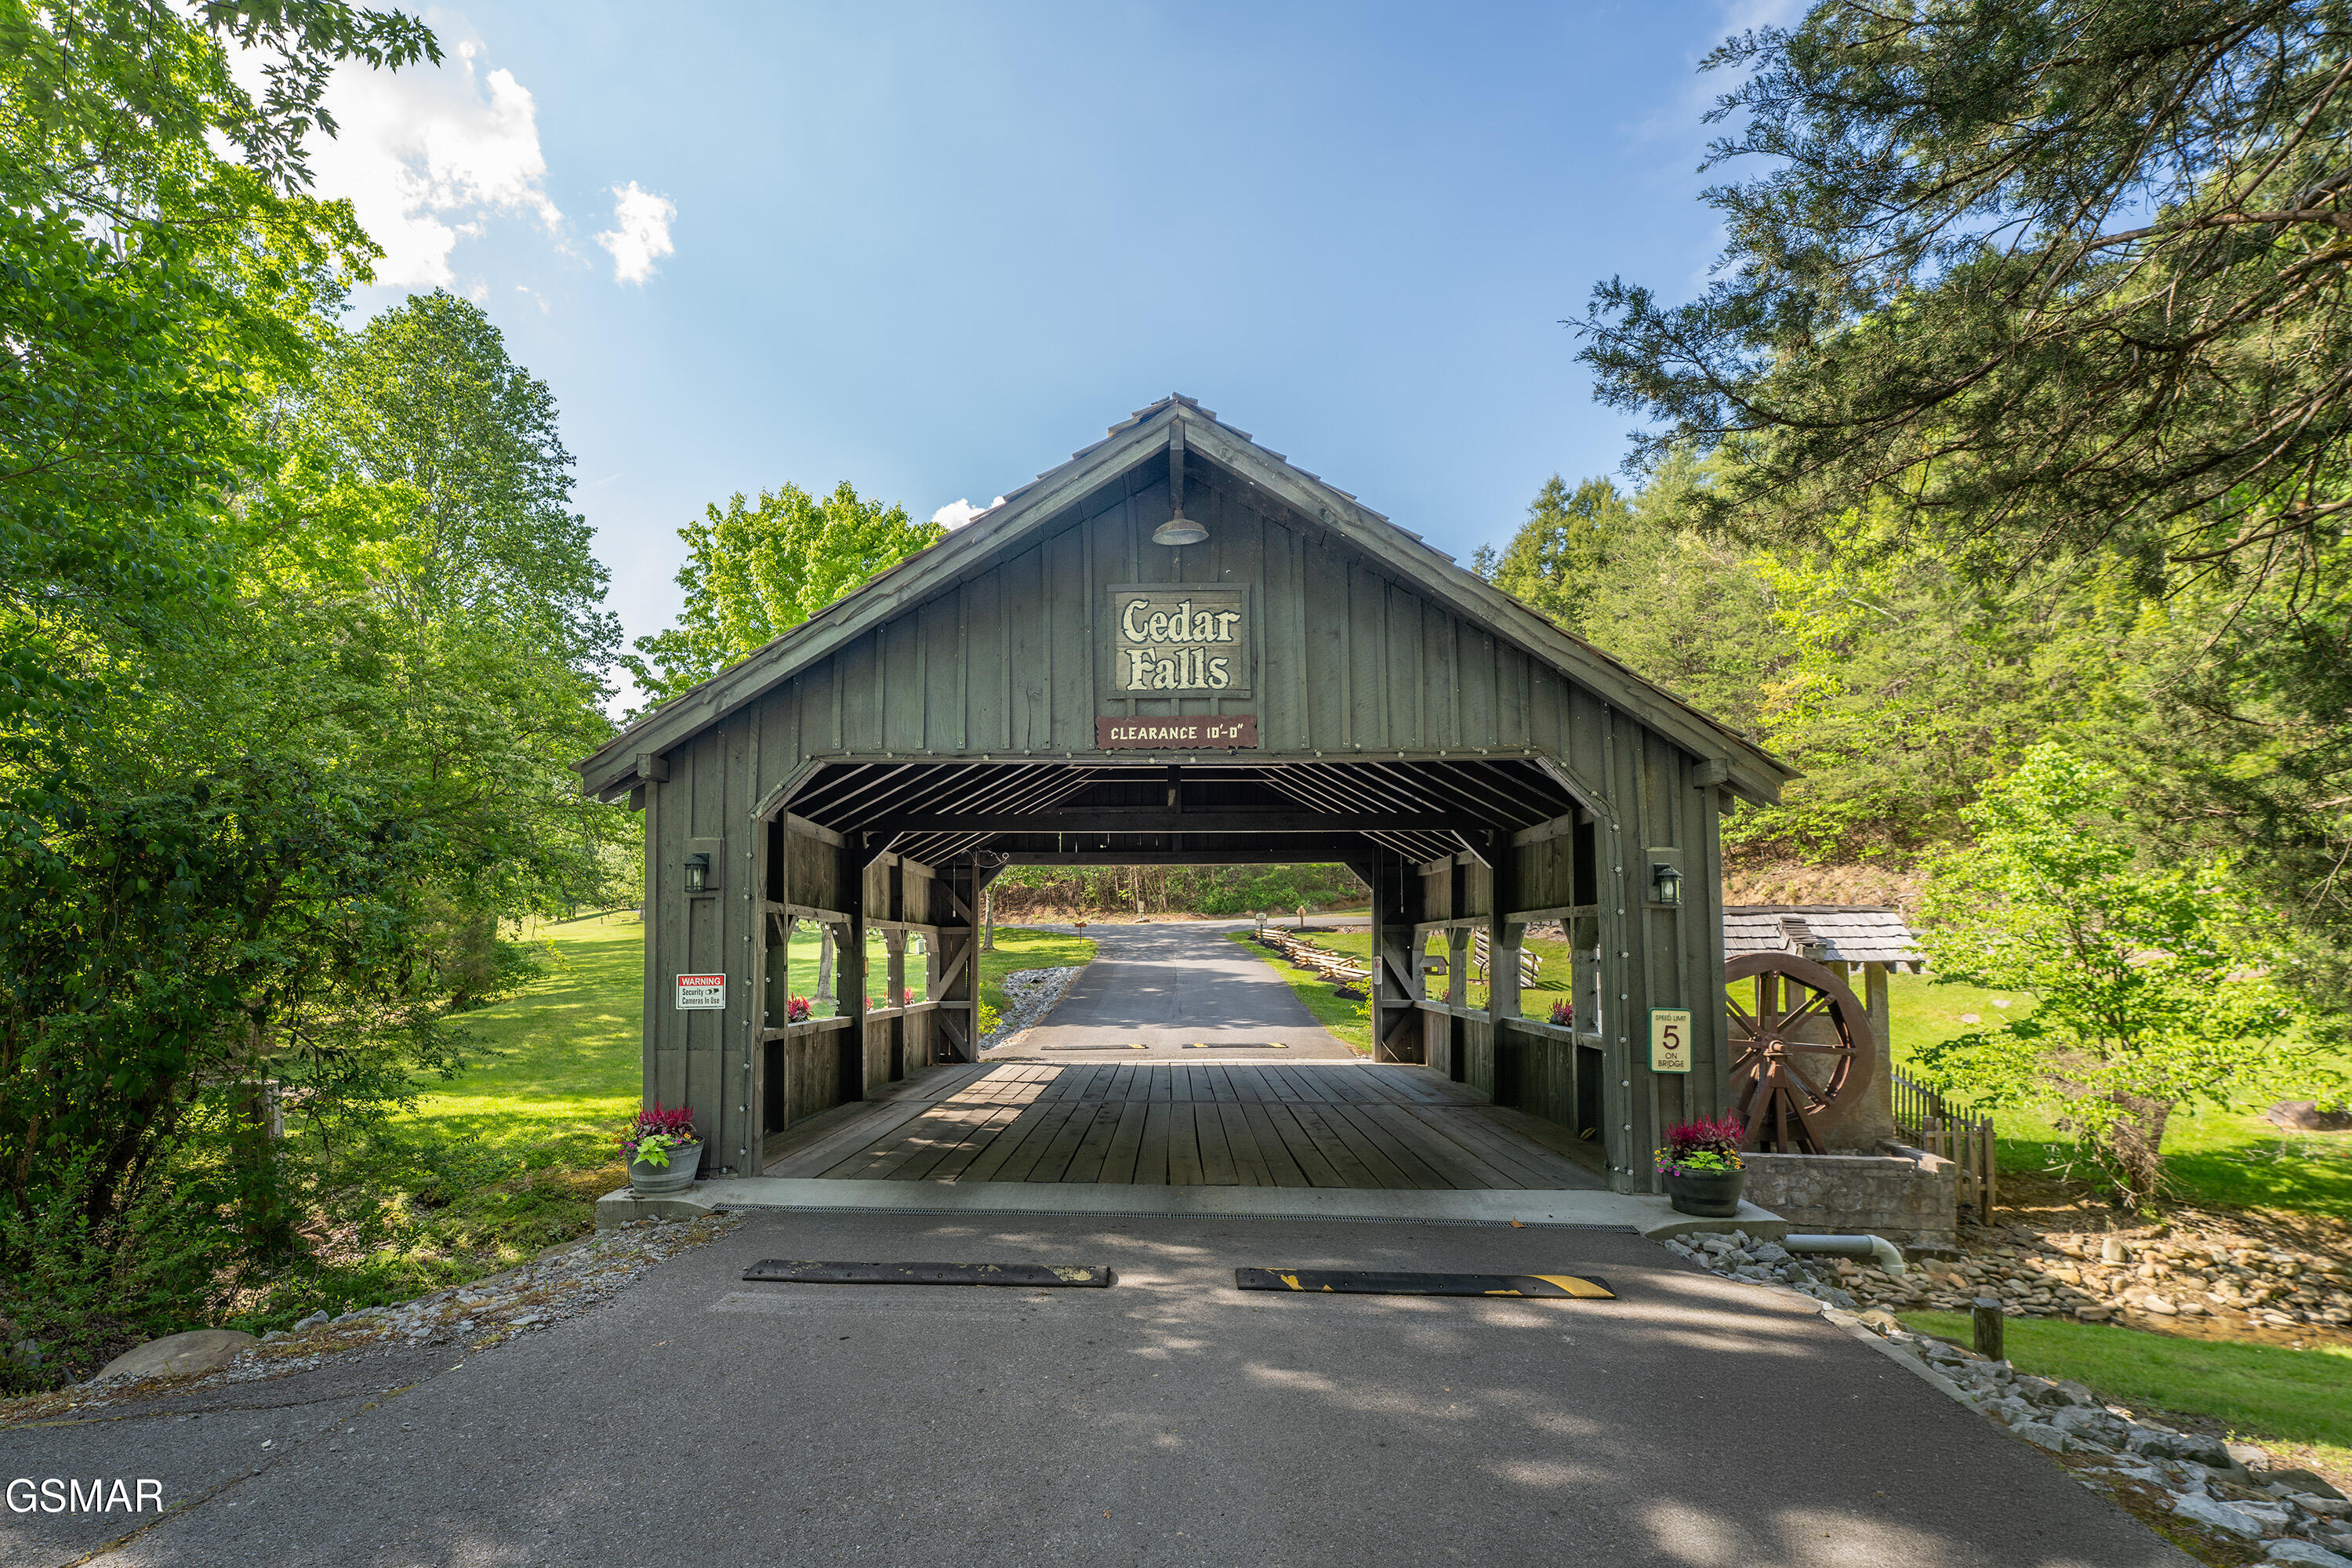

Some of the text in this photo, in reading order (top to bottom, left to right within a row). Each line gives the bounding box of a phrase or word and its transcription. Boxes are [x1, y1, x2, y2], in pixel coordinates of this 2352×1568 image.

[1122, 598, 1241, 643] Cedar
[1125, 647, 1230, 691] Falls
[1110, 727, 1197, 740] CLEARANCE
[1663, 1025, 1679, 1050] 5
